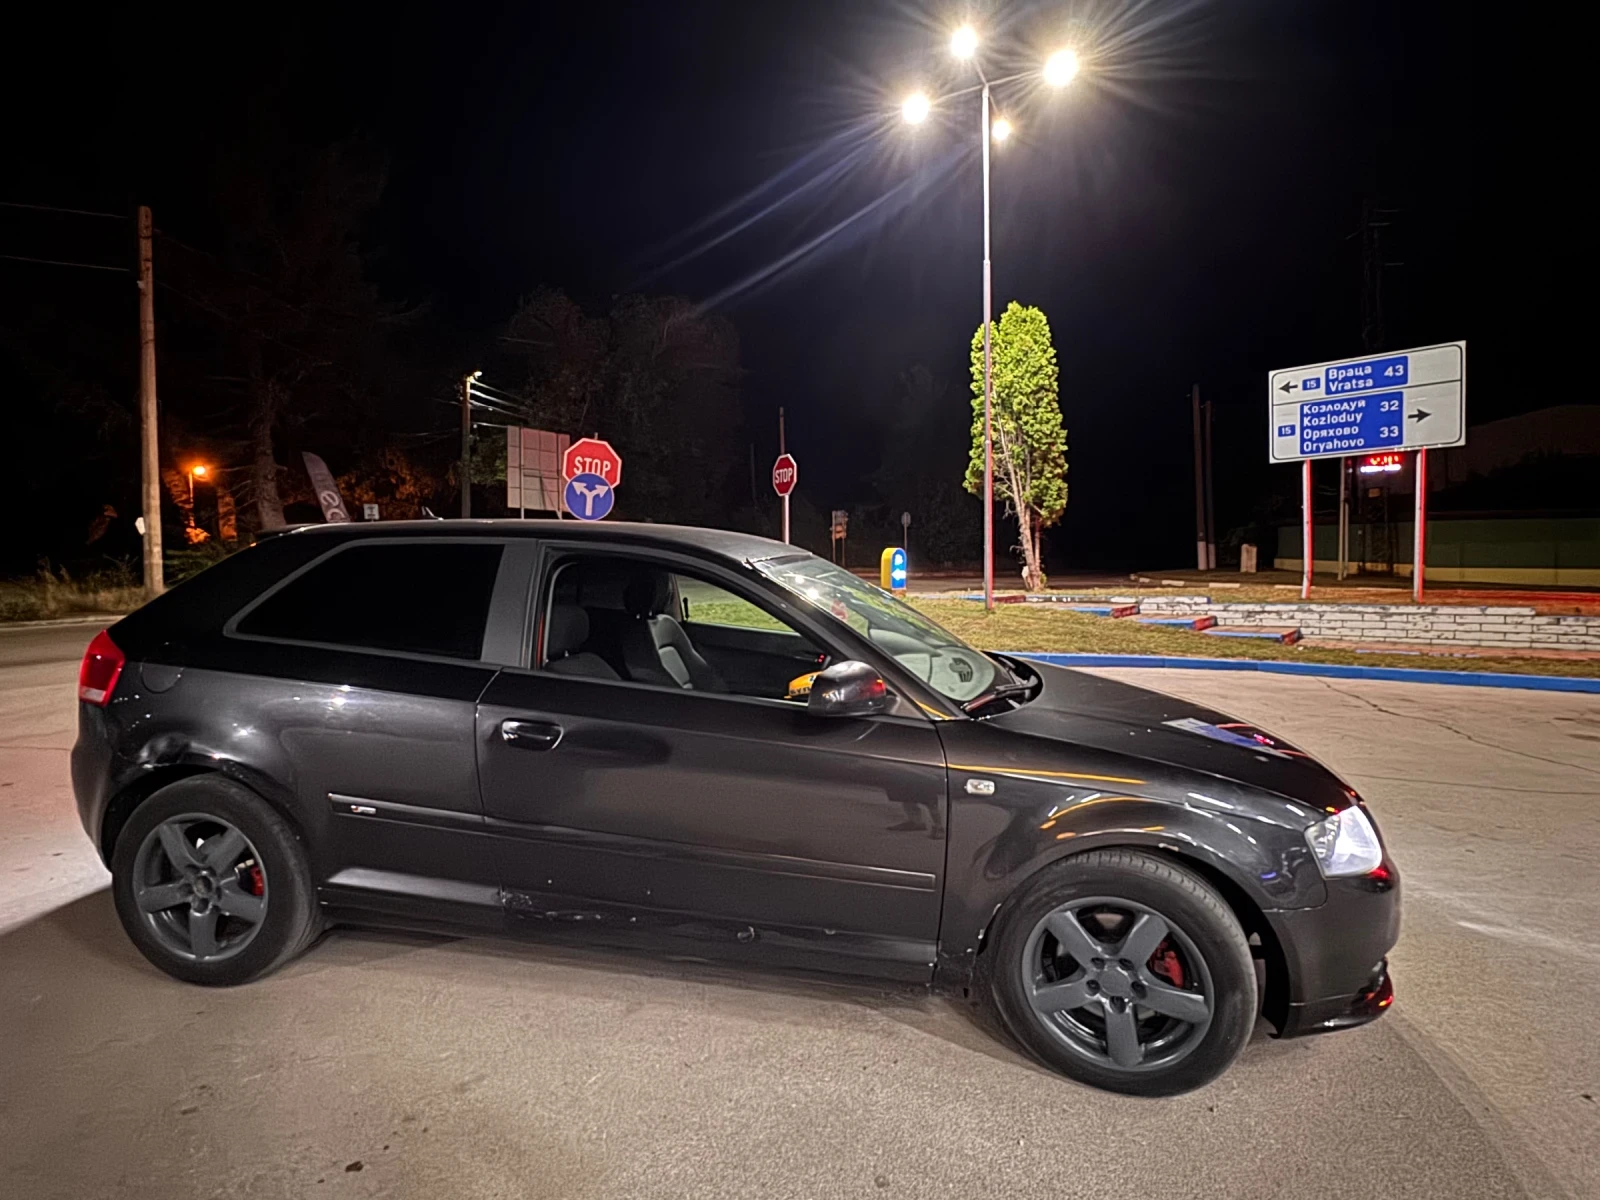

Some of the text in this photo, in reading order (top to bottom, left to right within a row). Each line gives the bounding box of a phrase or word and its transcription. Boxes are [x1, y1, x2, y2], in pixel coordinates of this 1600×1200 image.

[1329, 365, 1404, 380] Враца 43
[1305, 379, 1317, 389] 15
[1329, 379, 1373, 391] Vratsa
[1304, 400, 1399, 413] Козлодуй 32
[1304, 412, 1363, 426] Kozloduy
[1281, 426, 1292, 436] 15
[1304, 426, 1399, 440] Оряхово 33
[1304, 438, 1364, 452] Oryahovo
[574, 456, 611, 476] STOP
[775, 468, 793, 483] STOP
